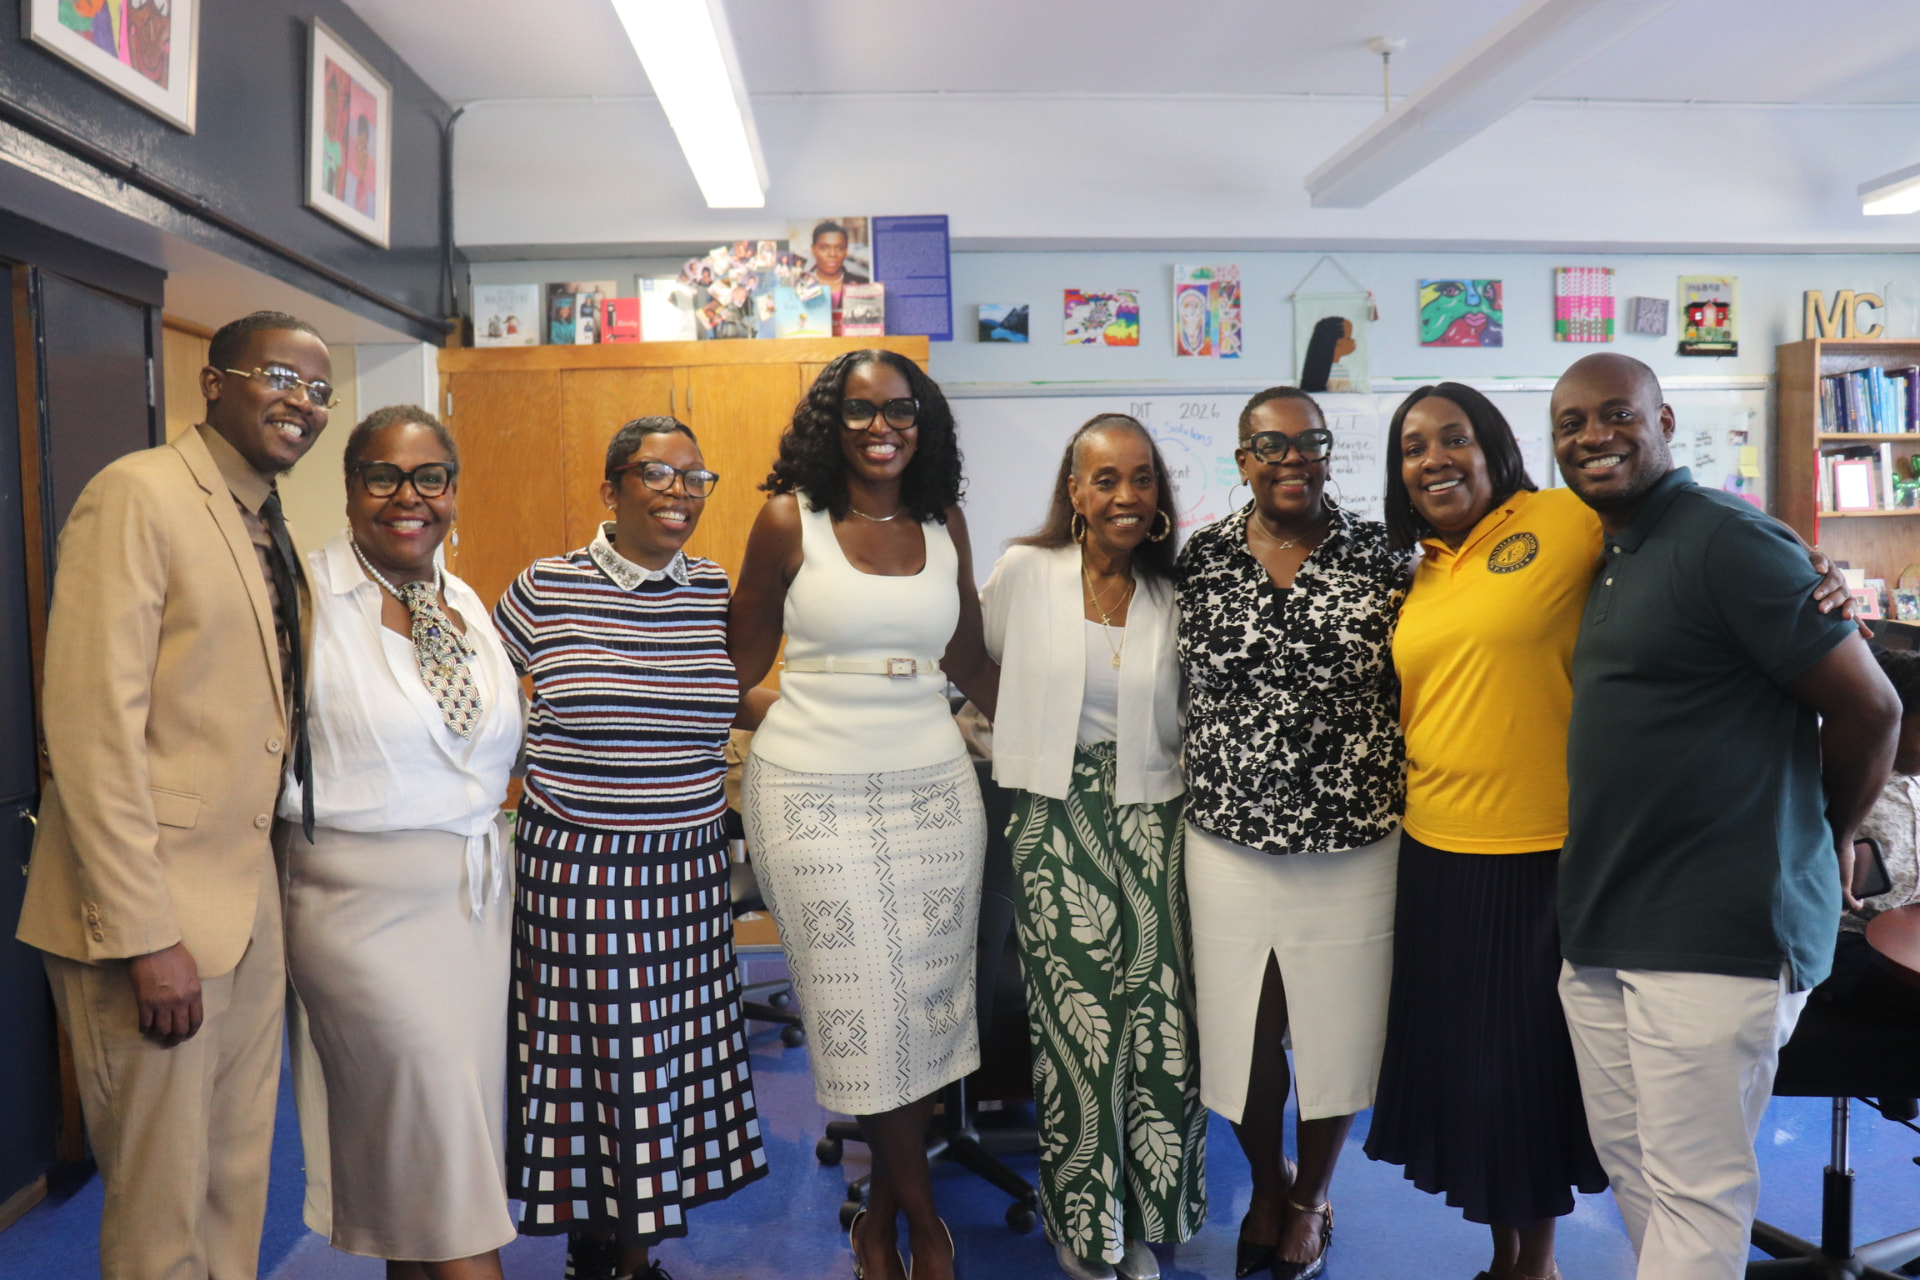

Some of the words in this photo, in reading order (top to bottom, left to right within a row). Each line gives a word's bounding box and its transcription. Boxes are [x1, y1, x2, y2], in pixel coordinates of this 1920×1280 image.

[1640, 298, 1666, 313] LOVE
[1803, 289, 1884, 340] MC
[1638, 318, 1664, 334] MOM
[1179, 402, 1220, 419] 2026
